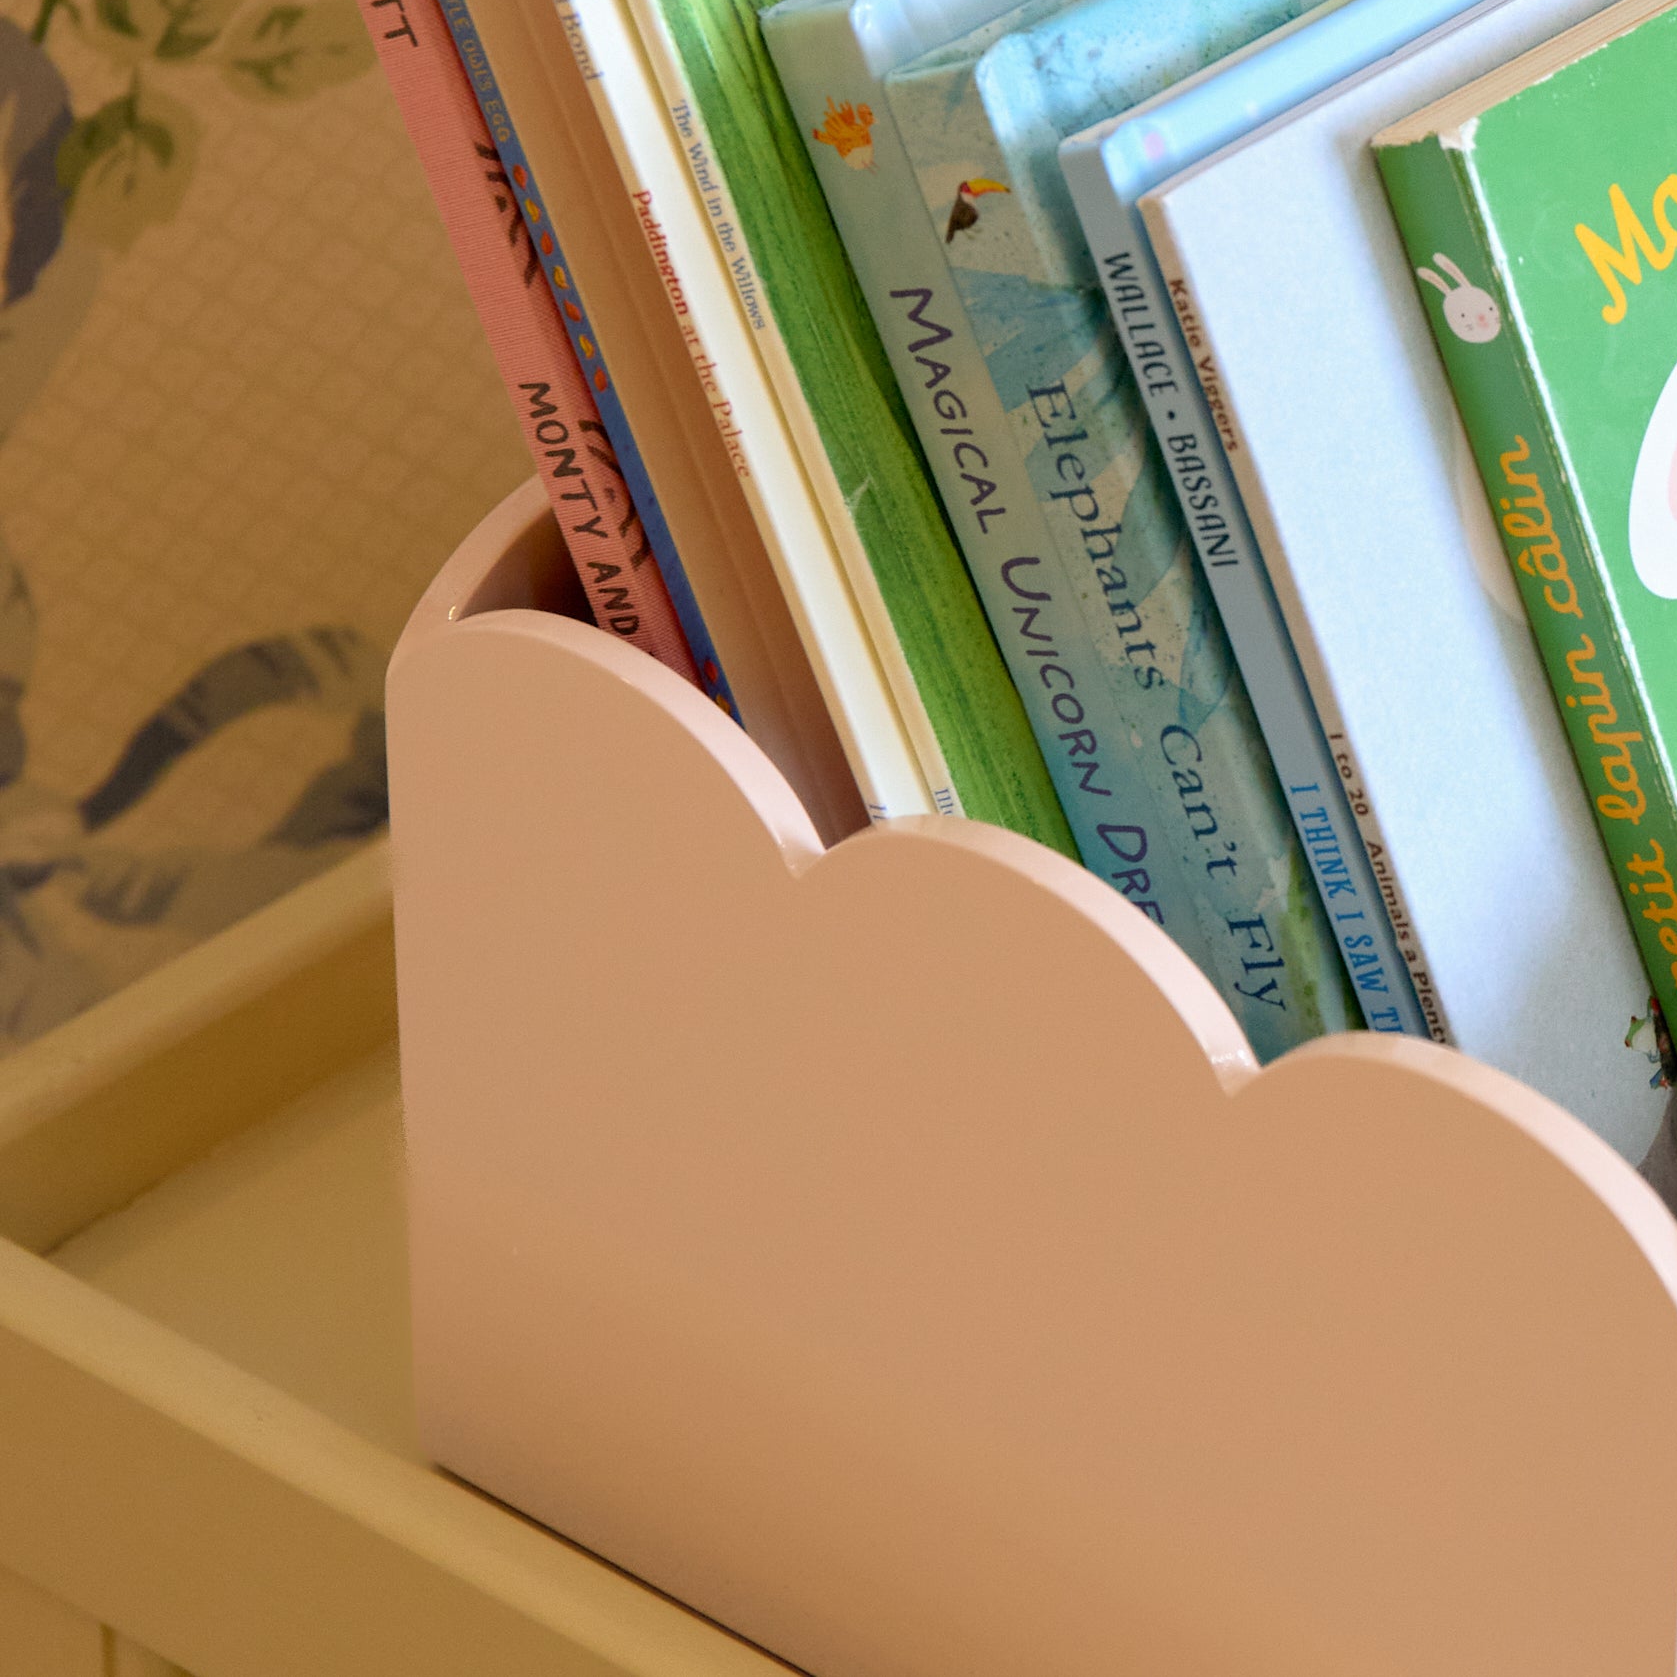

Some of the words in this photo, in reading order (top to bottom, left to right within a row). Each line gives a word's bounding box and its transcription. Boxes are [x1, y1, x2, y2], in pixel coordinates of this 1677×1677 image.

[484, 99, 511, 144] EGG
[672, 99, 693, 139] The
[687, 142, 719, 194] Wind
[716, 221, 737, 253] the
[731, 256, 767, 331] Willows
[632, 189, 690, 316] Paddington
[694, 354, 718, 393] the
[713, 400, 751, 478] Palace
[1104, 251, 1180, 398] WALLACE
[1168, 432, 1241, 568] BASSANI
[1169, 278, 1203, 349] Katie
[1199, 355, 1239, 453] Viggers
[518, 381, 609, 539] MONTY
[586, 561, 641, 637] AND
[889, 288, 1007, 535] MAGICAL
[1000, 556, 1113, 797] UNICORN
[1497, 433, 1584, 617] câlin
[1028, 378, 1167, 692] Elephants
[1159, 723, 1238, 880] Can't
[1226, 912, 1287, 1013] Fly
[1290, 781, 1321, 796] I
[1564, 634, 1648, 826] lapin
[1300, 806, 1358, 900] THINK
[1335, 751, 1353, 780] to
[1348, 789, 1370, 818] 20
[1366, 840, 1410, 942] Animals
[1335, 910, 1366, 924] I
[1343, 933, 1390, 995] SAW
